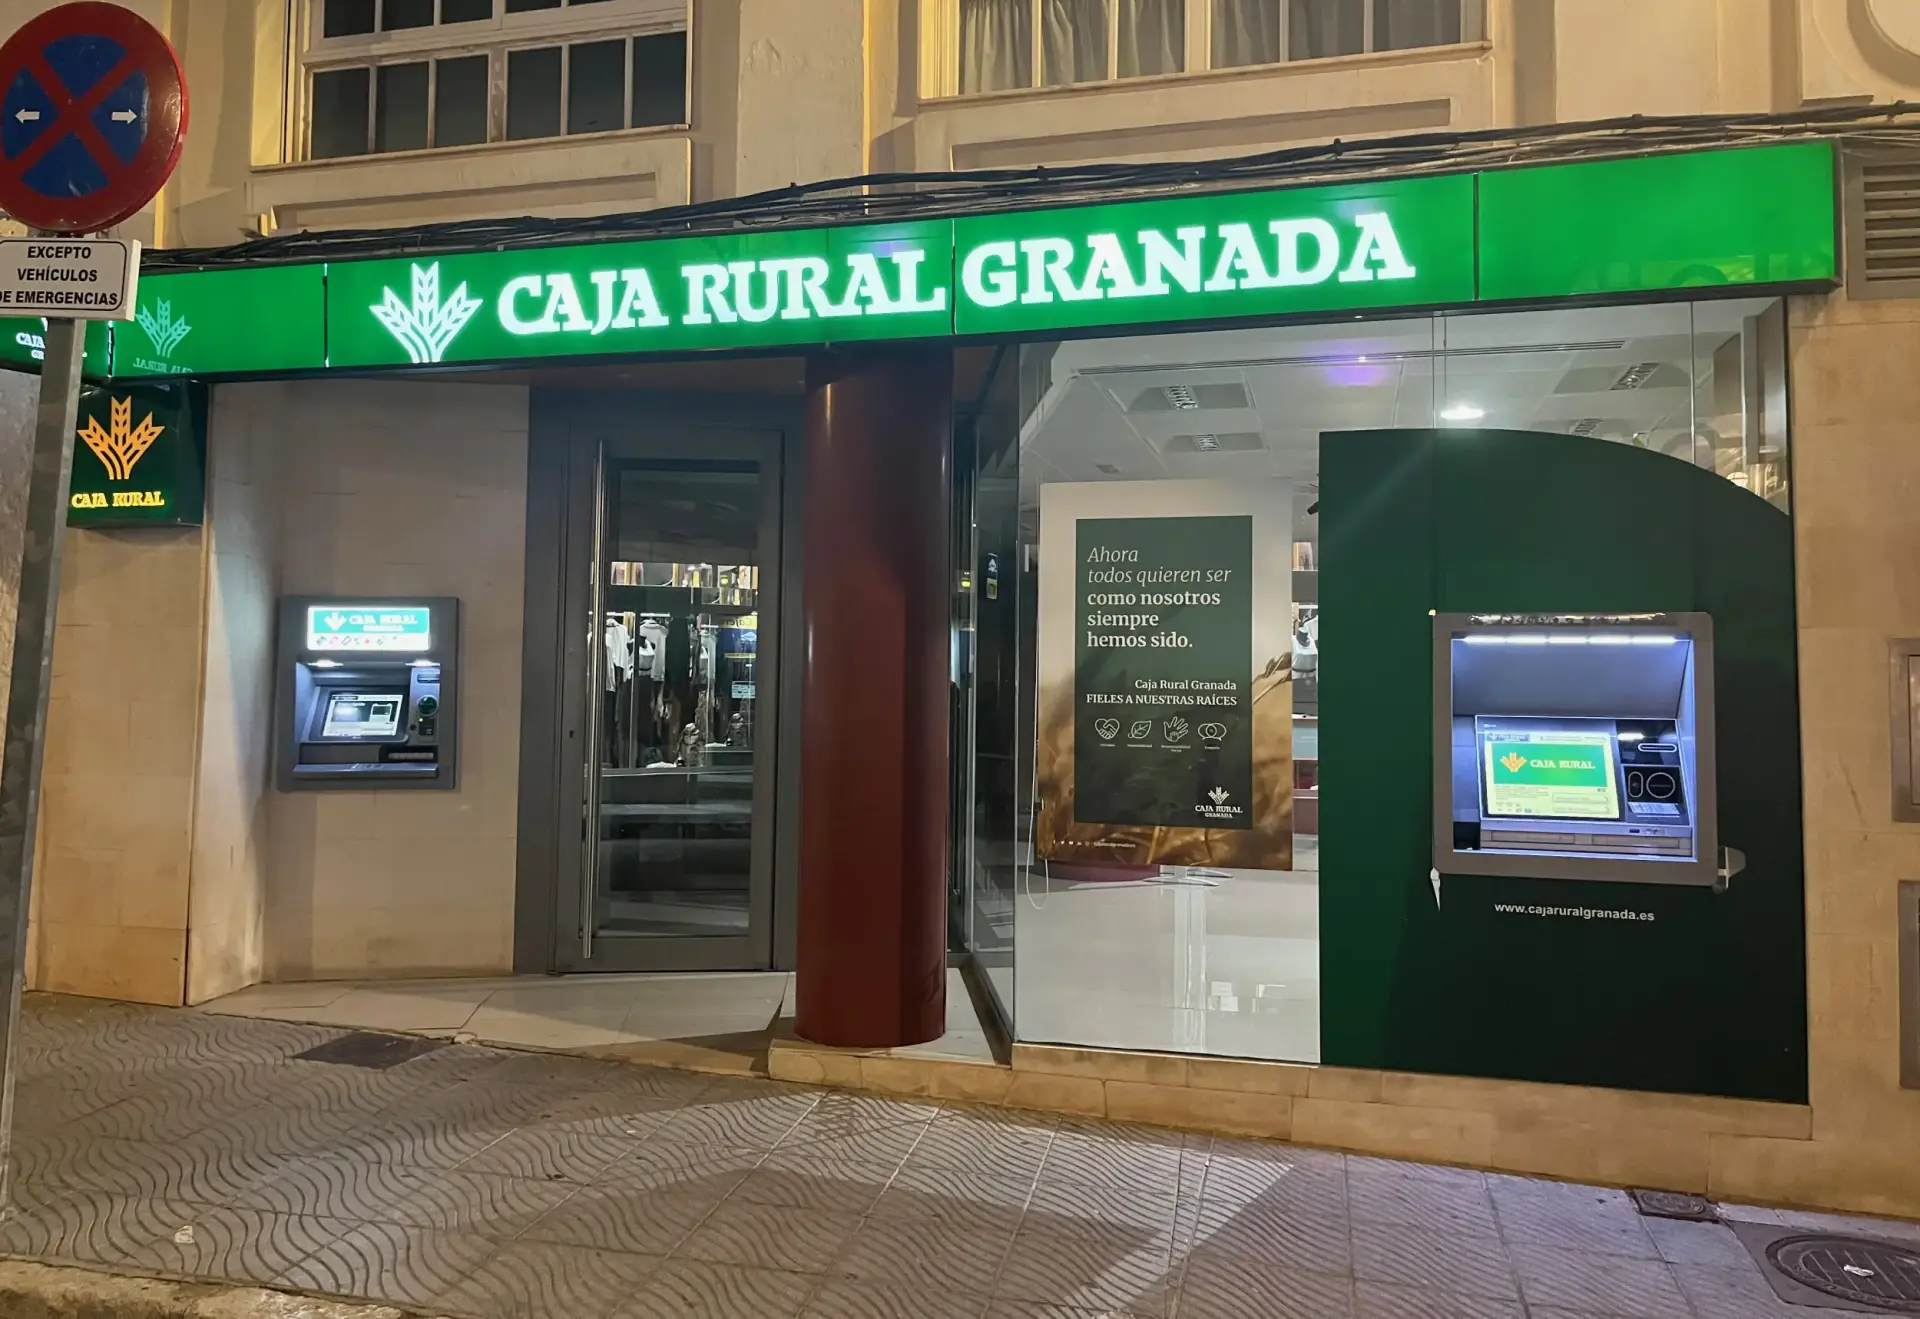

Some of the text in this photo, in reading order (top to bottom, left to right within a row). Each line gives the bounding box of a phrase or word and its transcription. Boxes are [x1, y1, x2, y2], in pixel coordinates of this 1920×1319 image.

[27, 246, 91, 259] EXCEPTO
[17, 265, 98, 282] VEHÍCULOS
[497, 212, 1416, 335] CAJA RURAL GRANADA
[0, 291, 118, 305] E EMERGENCIAS
[71, 491, 165, 508] CAJA RURAL
[1087, 546, 1139, 562] Ahora
[1088, 566, 1232, 587] todos quieren ser
[1087, 591, 1221, 605] como nosotros
[1087, 610, 1160, 630] siempre
[1087, 631, 1193, 648] hemos sido.
[1135, 679, 1237, 691] Caja Rural Granada
[1086, 693, 1237, 706] FIELES A NUESTRAS RAÍCES
[1529, 759, 1596, 770] CAJA RURAL
[1194, 804, 1244, 813] CAJA RURAL
[1494, 903, 1655, 921] www.cajaruralgranada.es
